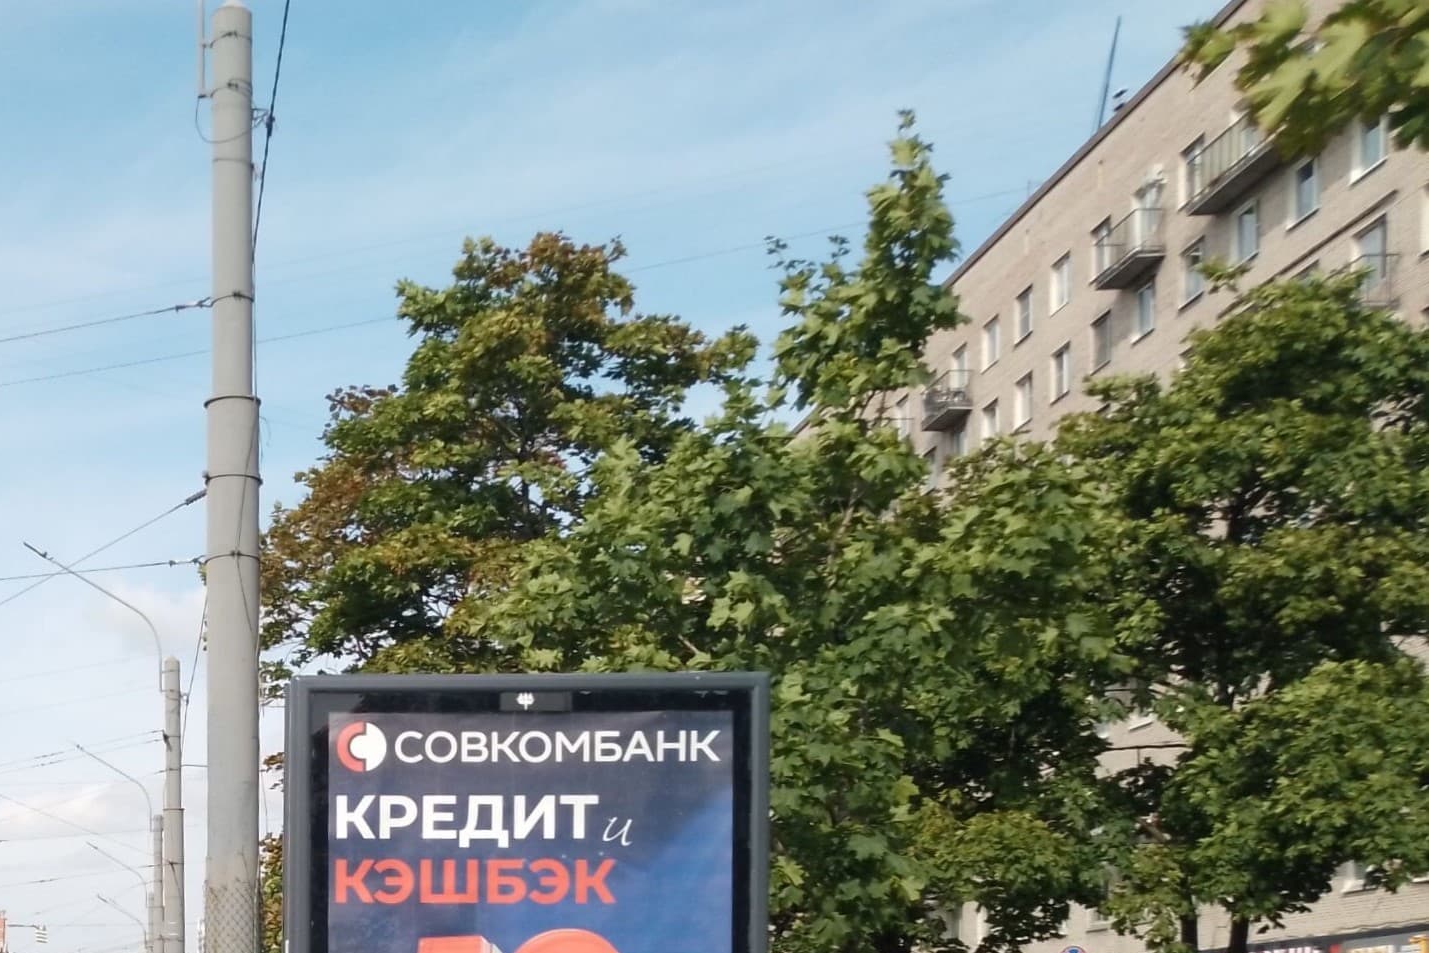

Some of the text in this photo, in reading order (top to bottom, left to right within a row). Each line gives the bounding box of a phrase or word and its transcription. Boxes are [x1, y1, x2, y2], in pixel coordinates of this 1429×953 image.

[394, 729, 721, 764] СОВКОМБАНК
[335, 794, 600, 848] КРЕДИТ
[335, 858, 616, 905] КЭШБЭК
